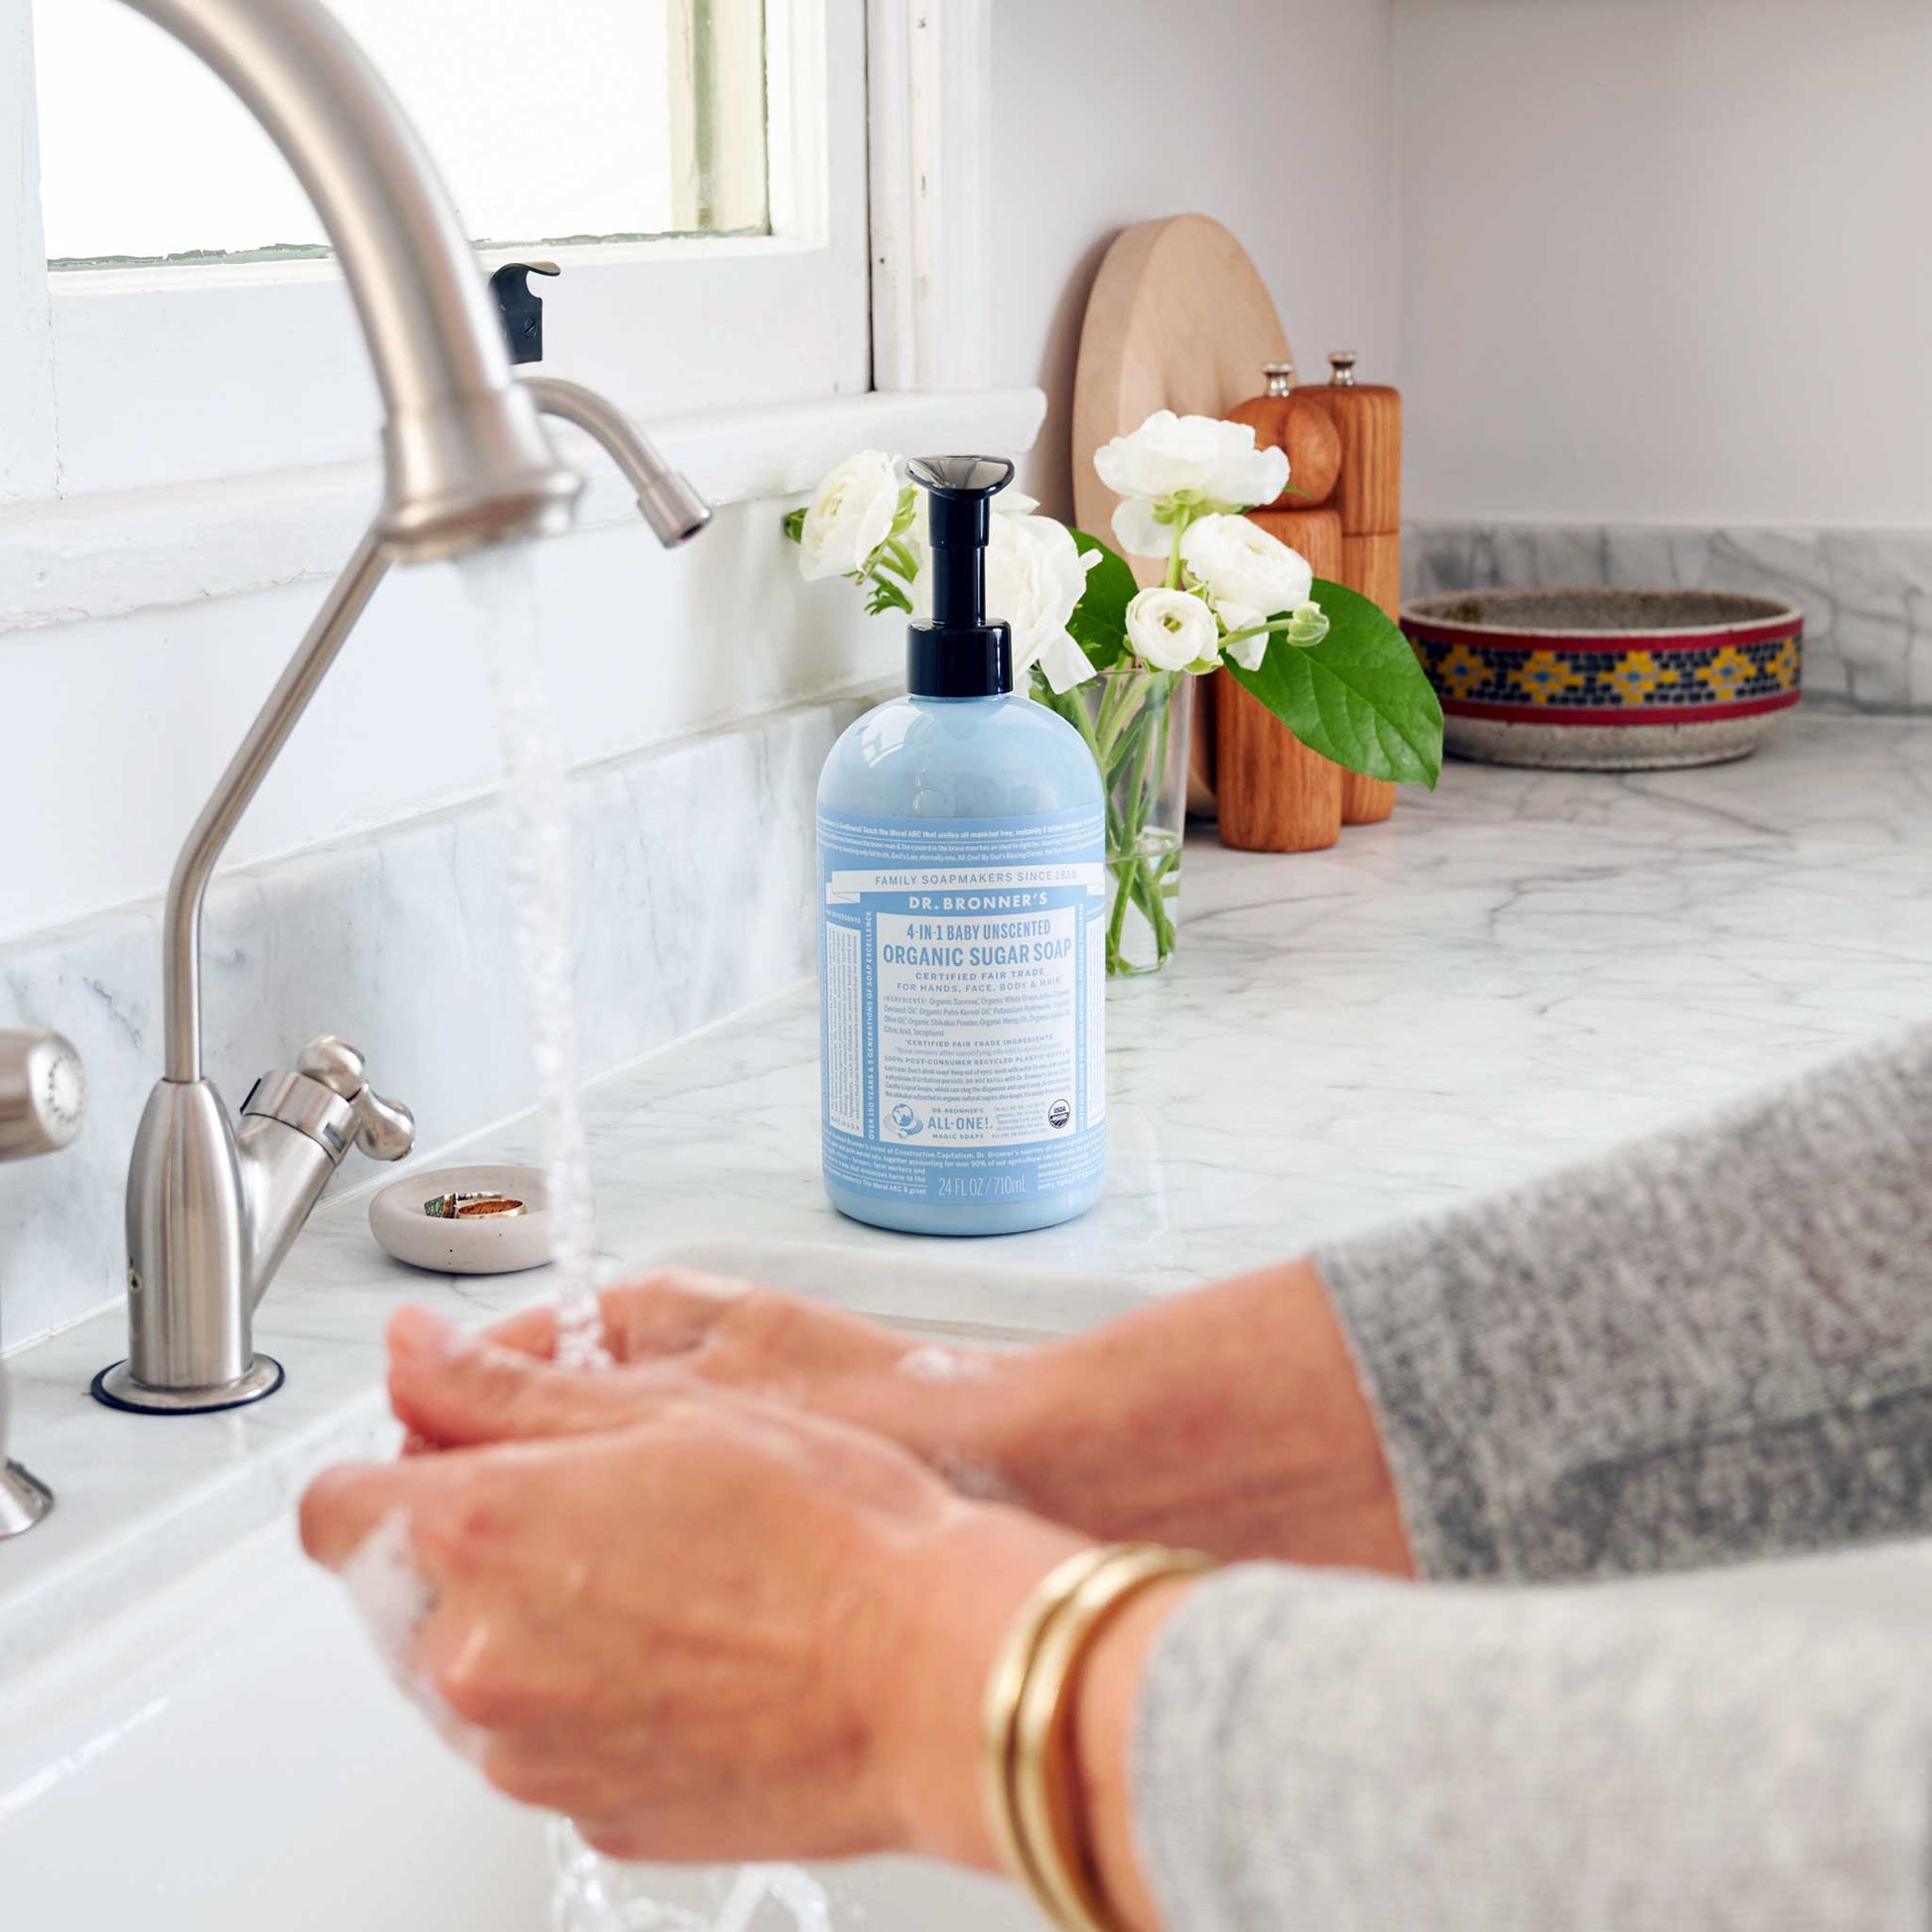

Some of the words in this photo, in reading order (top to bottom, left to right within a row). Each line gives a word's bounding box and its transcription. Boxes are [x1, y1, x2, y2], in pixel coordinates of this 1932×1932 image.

[923, 830, 937, 839] that
[876, 875, 917, 886] FAMILY
[921, 872, 1013, 885] SOAPMAKERS
[1017, 870, 1052, 882] SINCE
[909, 896, 939, 909] DR.
[943, 892, 1048, 910] BRONNER'S
[906, 923, 943, 941] 4-IN-1
[947, 924, 980, 941] BABY
[983, 918, 1050, 940] UNSCENTED
[884, 943, 964, 967] ORGANIC
[969, 943, 1030, 967] SUGAR
[1034, 937, 1072, 962] SOAP
[915, 972, 977, 981] CERTIFIED
[981, 971, 1007, 981] FAIR
[1011, 967, 1045, 978] TRADE
[866, 987, 874, 999] OF
[920, 984, 961, 993] HANDS,
[965, 983, 997, 993] FACE,
[905, 1056, 971, 1066] POST-CONSUMER
[1015, 1053, 1044, 1062] PLASTIC
[927, 1116, 989, 1130] ALL-ONE!
[894, 1148, 935, 1158] Constructive
[937, 1177, 951, 1195] 24
[955, 1177, 967, 1196] FL
[969, 1177, 984, 1195] OZ
[993, 1173, 1027, 1195] 710mL
